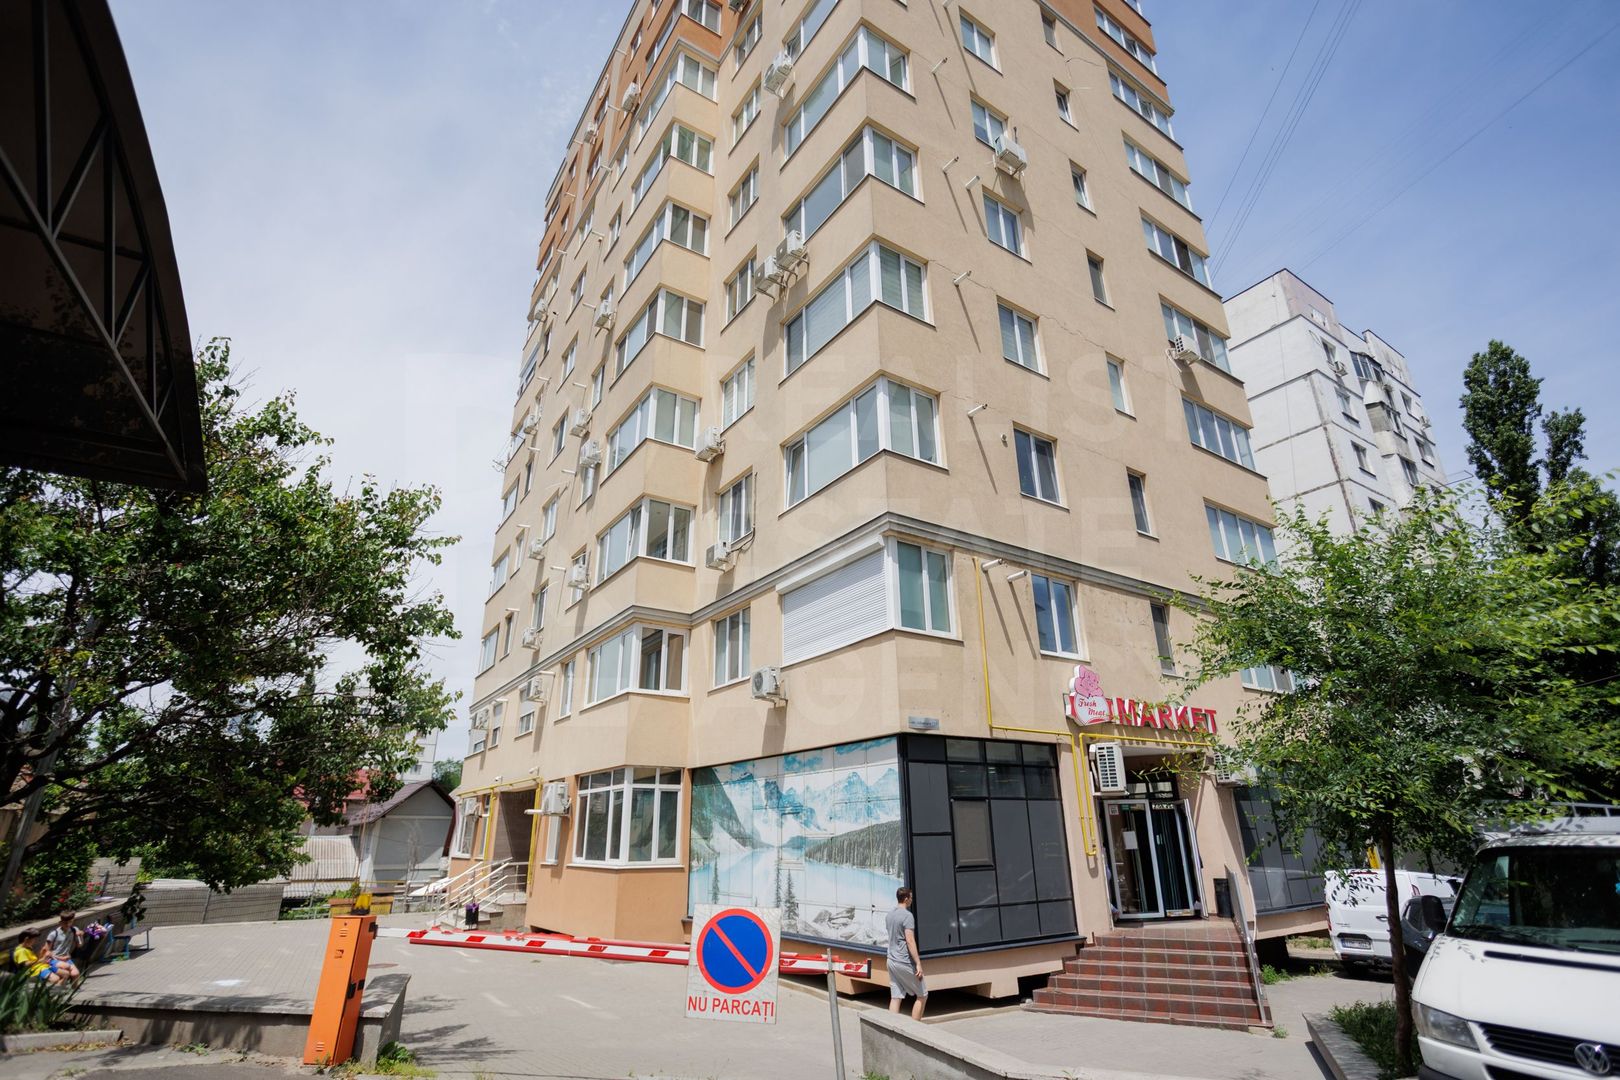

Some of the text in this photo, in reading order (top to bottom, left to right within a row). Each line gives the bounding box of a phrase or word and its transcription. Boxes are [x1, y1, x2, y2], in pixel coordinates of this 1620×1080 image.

[1078, 698, 1097, 707] Fresh
[1116, 697, 1217, 734] MARKET
[688, 995, 707, 1012] NU
